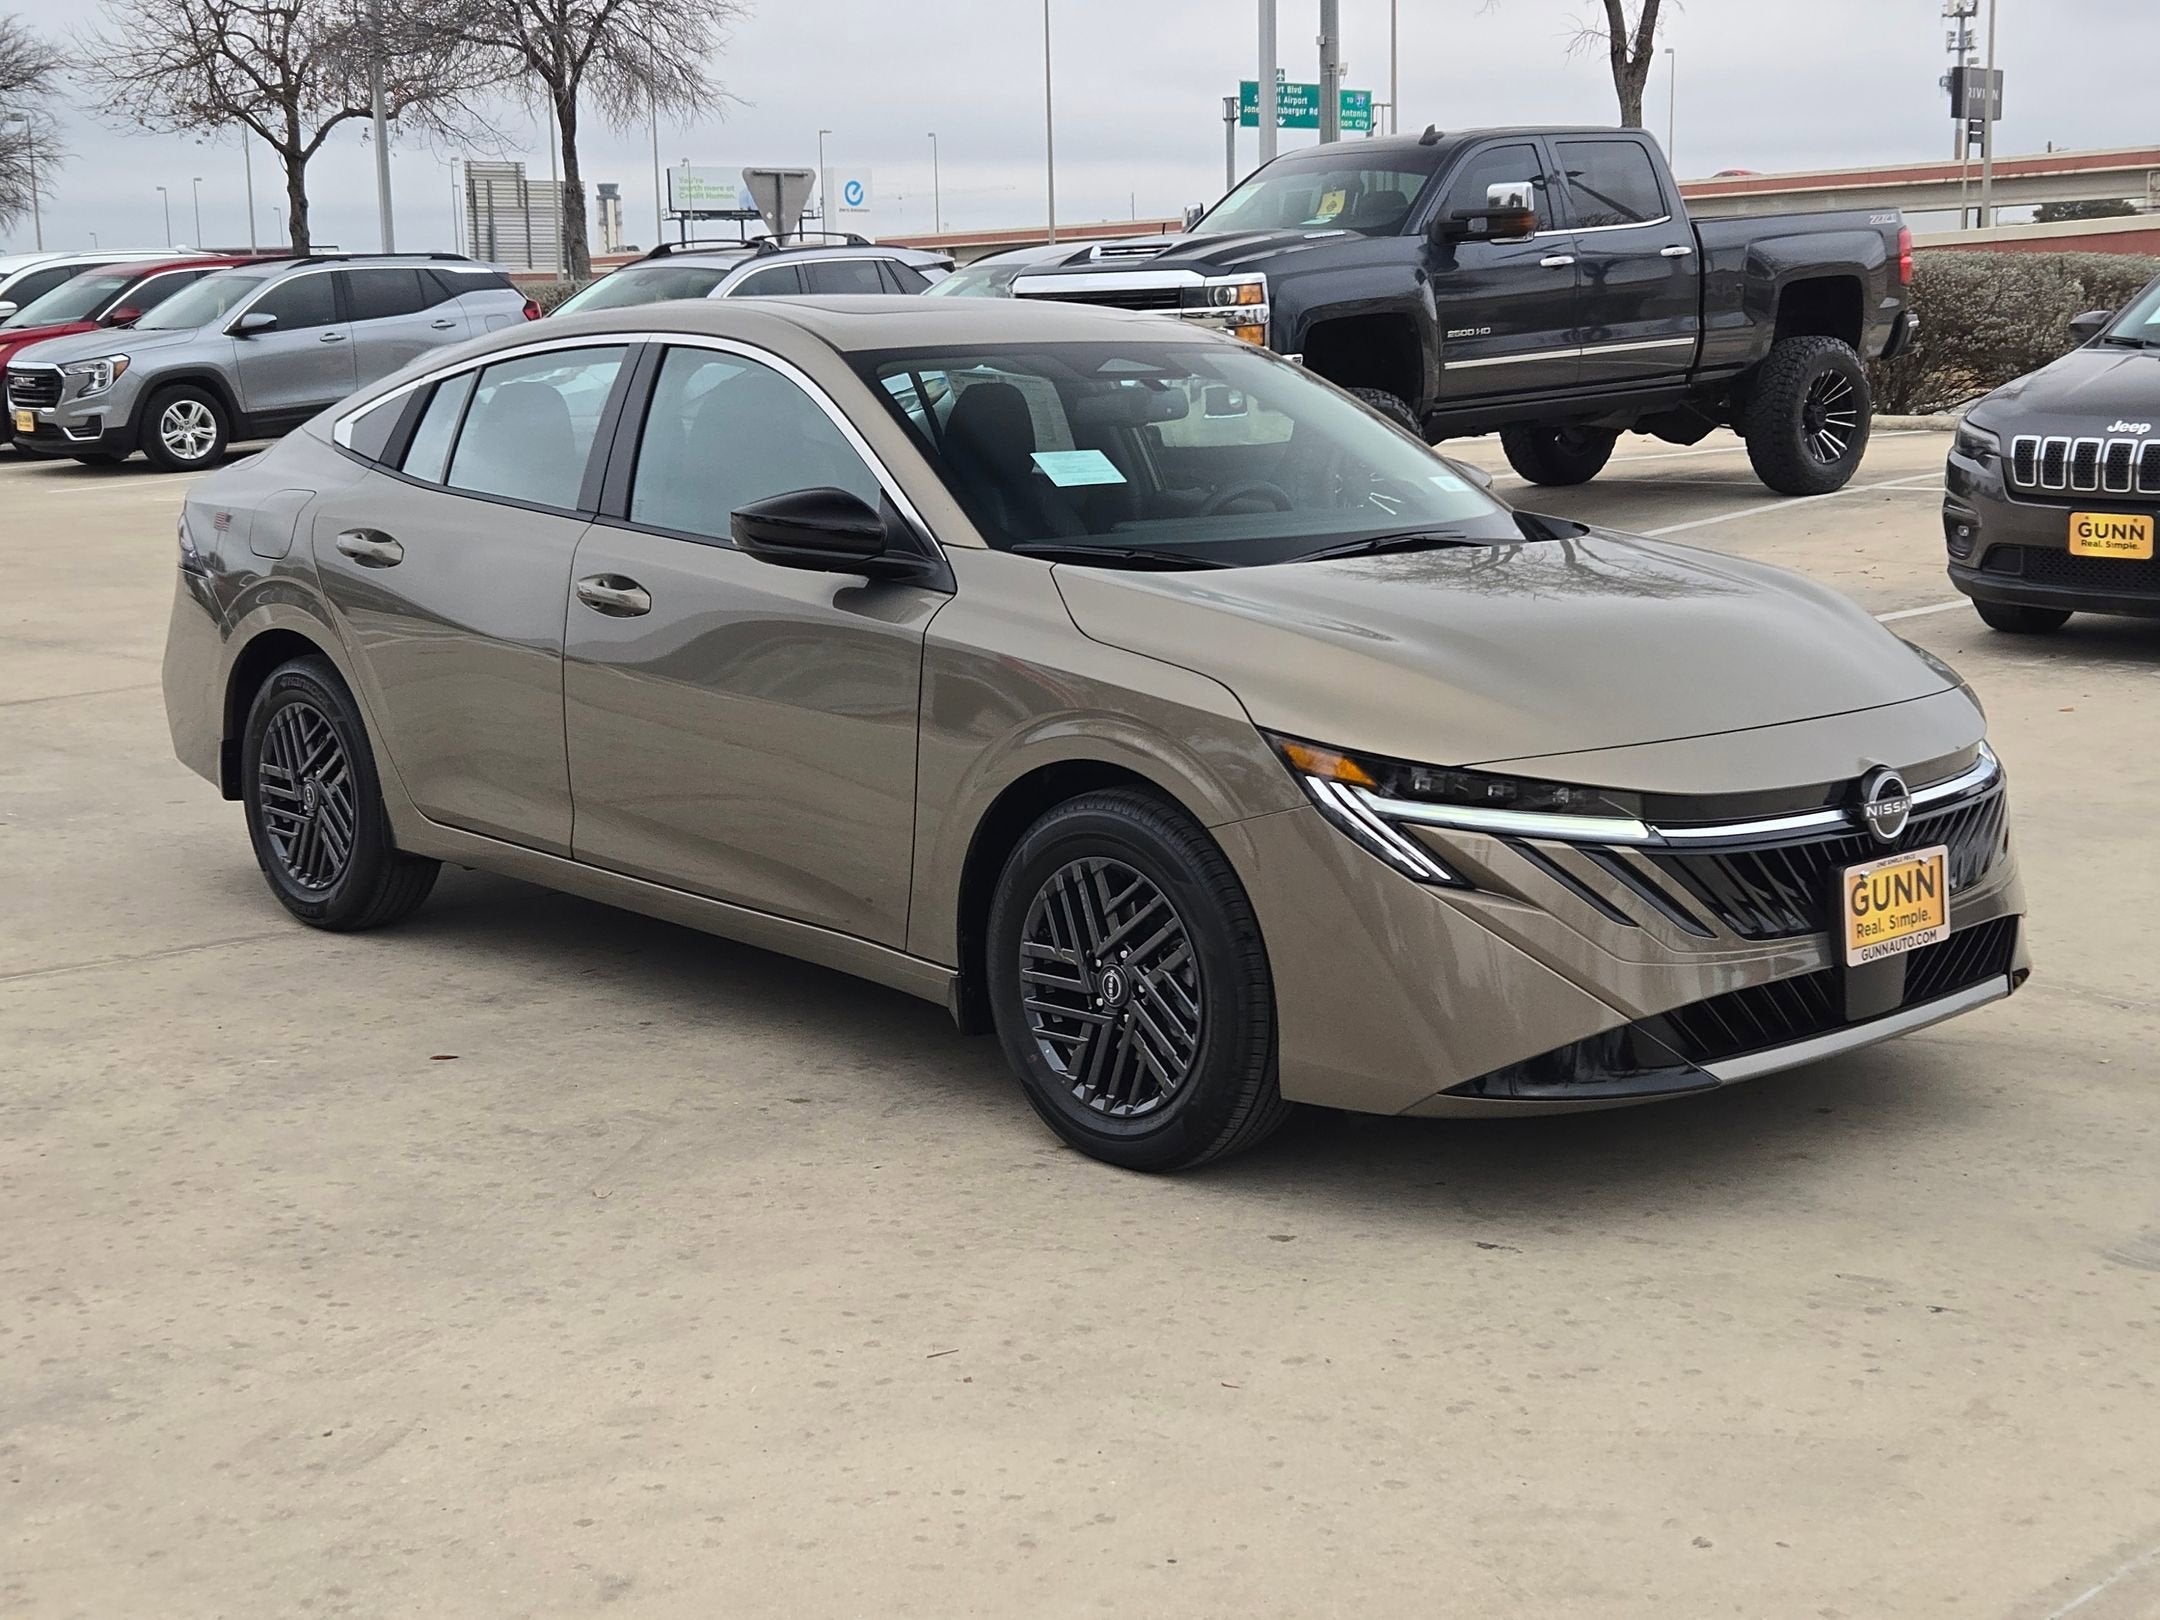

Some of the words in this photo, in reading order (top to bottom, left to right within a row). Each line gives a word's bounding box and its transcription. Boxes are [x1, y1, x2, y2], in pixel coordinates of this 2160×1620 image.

[1287, 86, 1302, 94] Blvd
[1968, 87, 1999, 101] RIVIN
[1283, 96, 1308, 106] Airport
[1309, 107, 1318, 115] Rd
[1341, 109, 1368, 118] Antonio
[1355, 119, 1368, 130] City
[2106, 420, 2152, 434] Jeep
[2077, 521, 2145, 541] GUNN
[2081, 539, 2103, 549] Real.
[2105, 540, 2140, 551] Simple.
[1851, 864, 1935, 917] GUNN
[1855, 919, 1885, 939] Real.
[1889, 909, 1932, 931] Simple.
[1861, 929, 1937, 962] GUNNAUTO.COM
